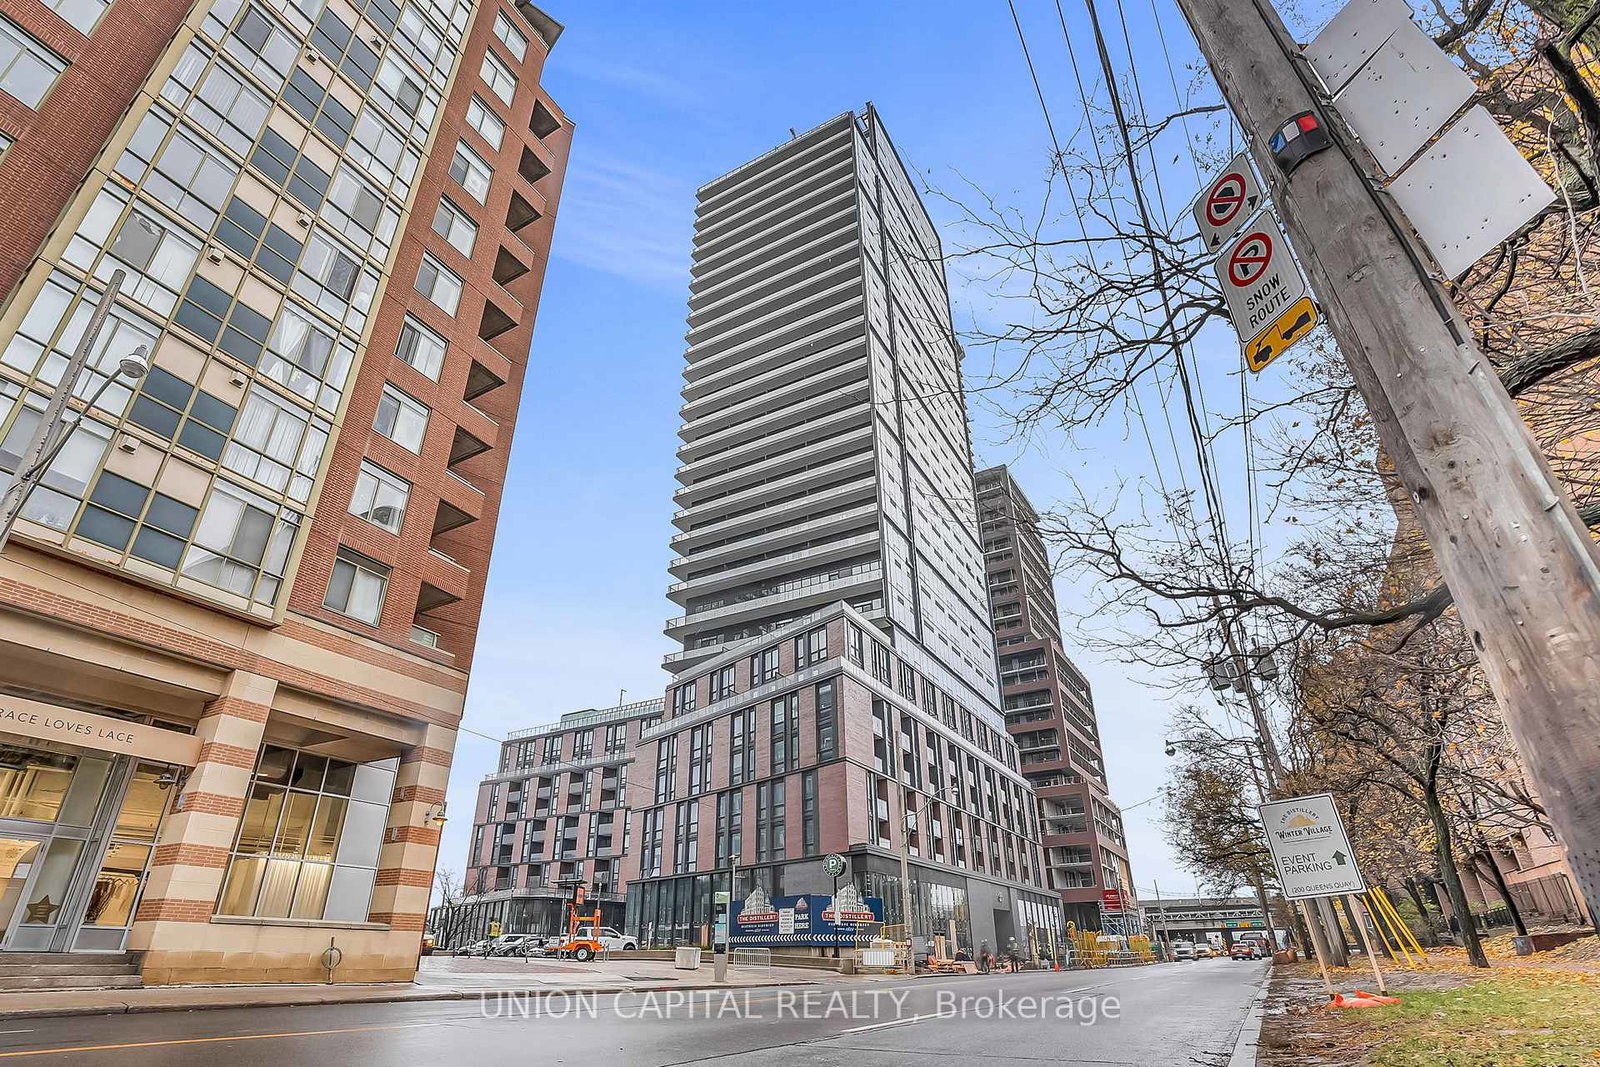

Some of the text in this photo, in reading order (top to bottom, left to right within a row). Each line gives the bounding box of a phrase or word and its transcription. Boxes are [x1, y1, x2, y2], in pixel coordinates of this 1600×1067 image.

[1246, 273, 1280, 311] SNOW
[1249, 286, 1291, 329] ROUTE
[44, 717, 92, 735] LOVES
[98, 728, 135, 744] LACE
[1287, 807, 1320, 820] DISTILLERY
[829, 859, 837, 869] P
[1281, 852, 1316, 866] EVENT
[1284, 861, 1333, 875] PARKING
[1291, 880, 1356, 894] (200 QUEENS QUAY)
